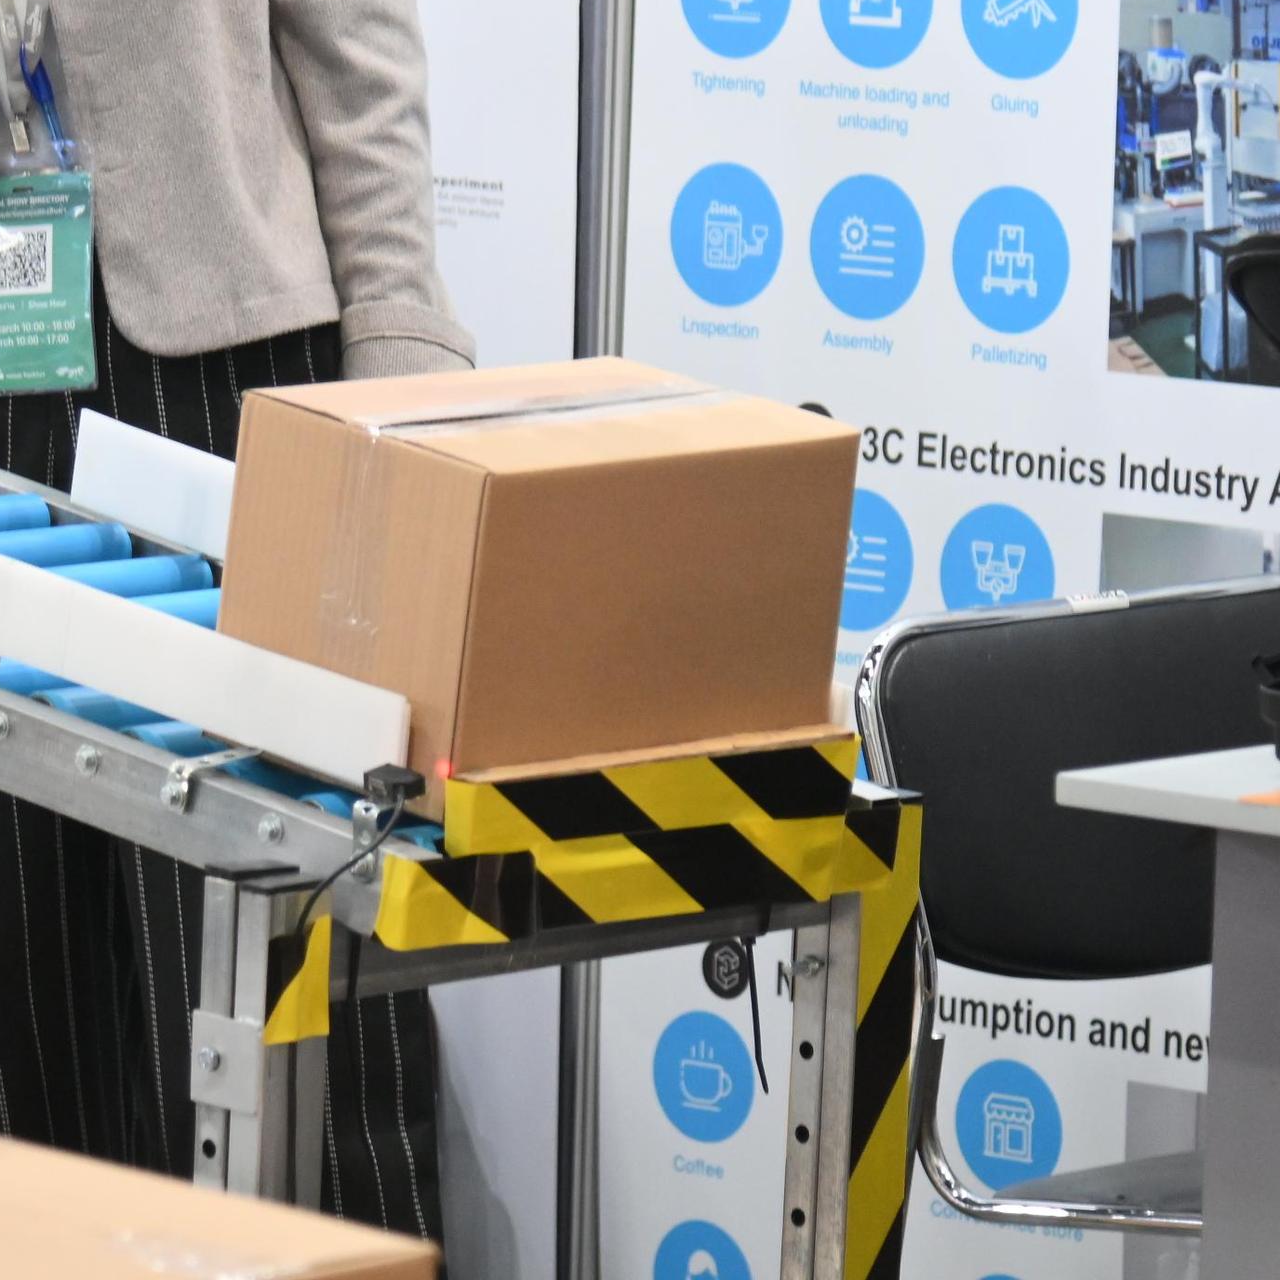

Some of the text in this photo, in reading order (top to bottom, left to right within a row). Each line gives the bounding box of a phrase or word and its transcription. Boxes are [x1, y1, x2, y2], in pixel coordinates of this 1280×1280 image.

[691, 70, 766, 98] Tightening
[799, 79, 951, 109] Machine loading and
[991, 93, 1040, 118] Gluing
[837, 112, 910, 137] unloading
[822, 328, 895, 355] Assembly
[970, 342, 1048, 371] Palletizing
[862, 425, 905, 465] 3C
[917, 431, 1107, 487] Electronics
[1118, 452, 1261, 513] Industry
[938, 990, 1211, 1063] umption and ne
[673, 1154, 725, 1180] Coffee
